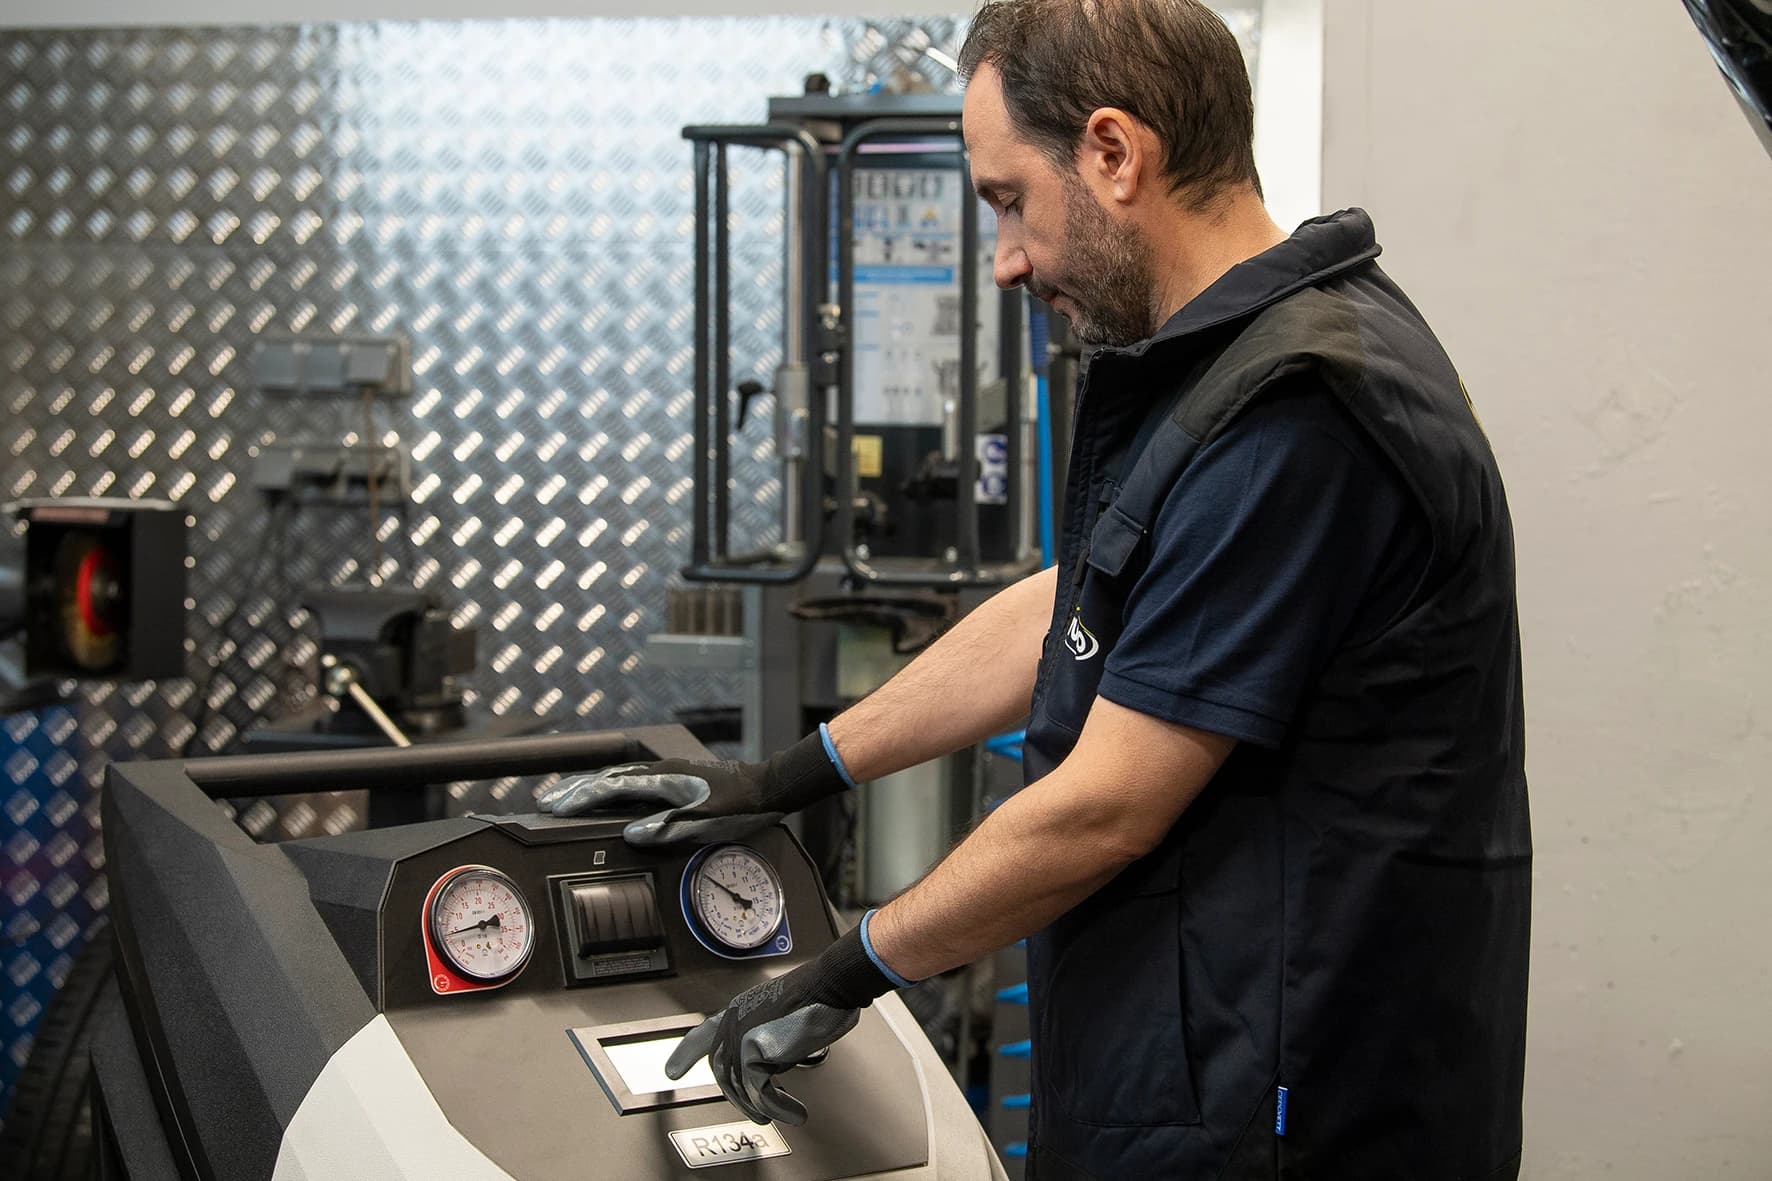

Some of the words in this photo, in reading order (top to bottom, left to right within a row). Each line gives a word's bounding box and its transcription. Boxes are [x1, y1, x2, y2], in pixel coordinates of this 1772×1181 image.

[474, 897, 482, 905] 20
[456, 912, 463, 920] 10
[691, 1131, 770, 1157] R134a
